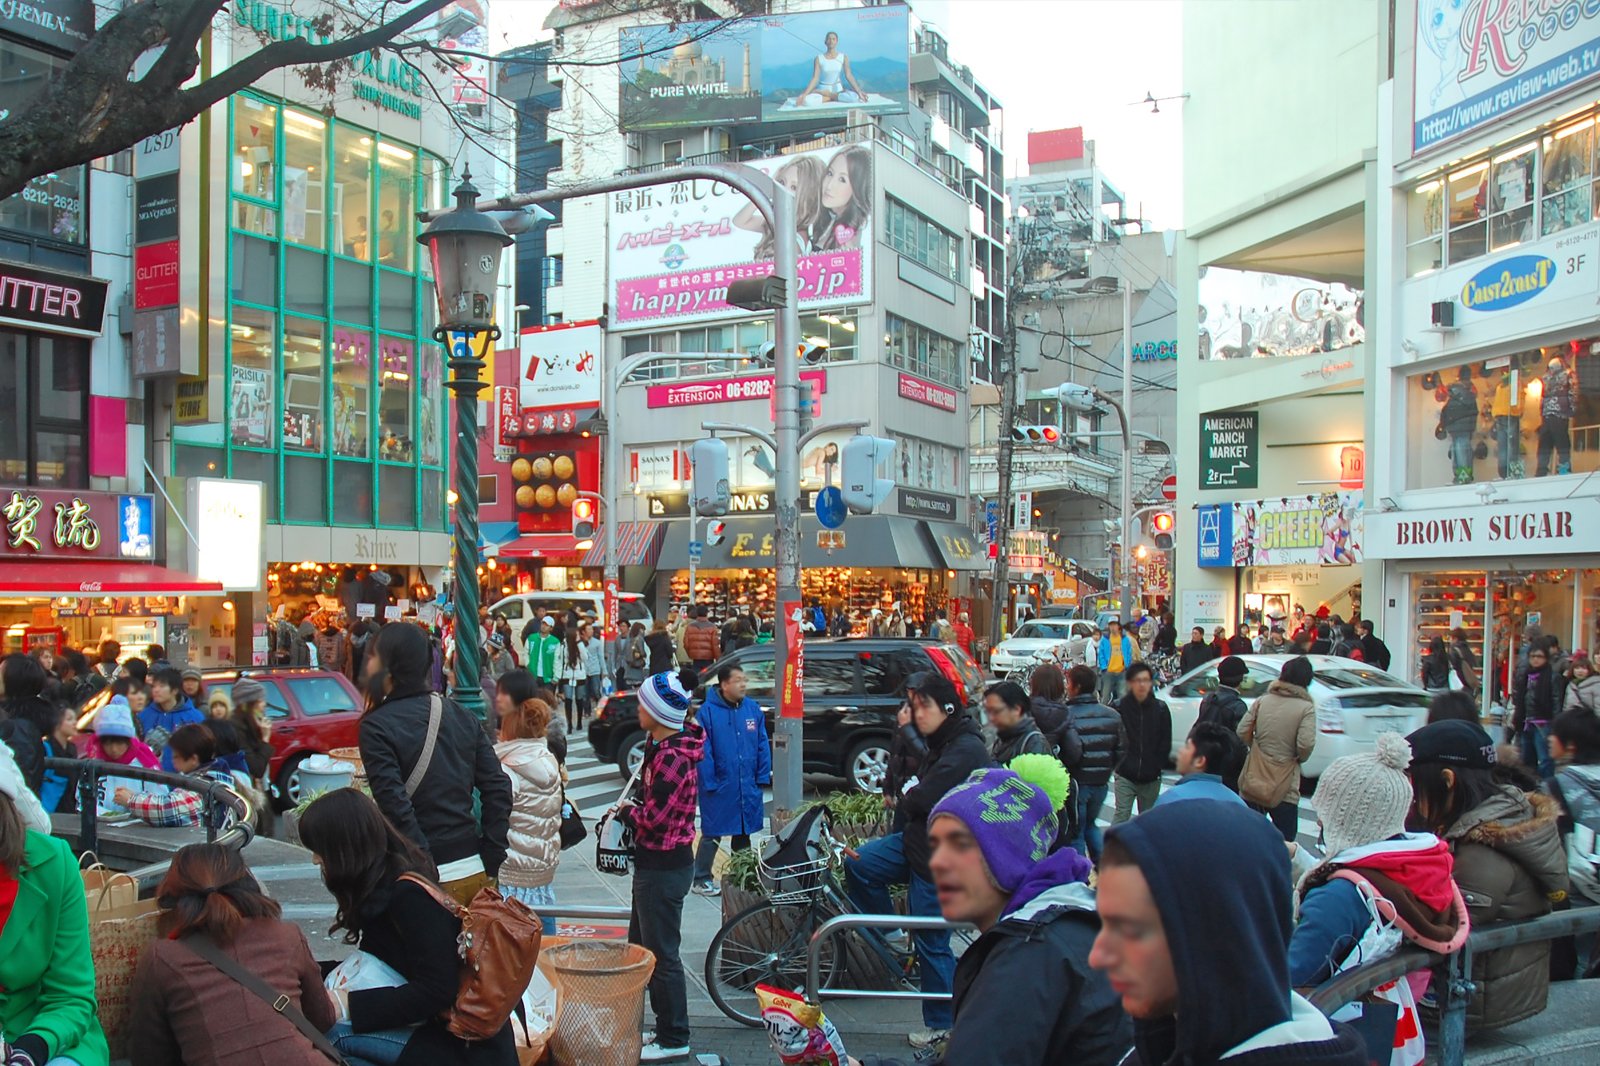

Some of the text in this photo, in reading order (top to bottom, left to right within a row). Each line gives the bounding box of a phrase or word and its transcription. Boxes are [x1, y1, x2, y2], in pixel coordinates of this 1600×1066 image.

[235, 0, 330, 45] SUNCIT
[650, 82, 729, 98] PURE WHITE
[144, 132, 174, 154] LSD
[615, 178, 741, 214] 最近、恋して
[617, 217, 732, 251] ハッピーメール
[137, 262, 178, 280] GLITTER
[1566, 254, 1586, 274] 3F
[1122, 340, 1177, 362] ARCO
[232, 368, 265, 382] PRISILA
[668, 380, 776, 404] EXTENSION 06-6282-
[1205, 417, 1253, 431] AMERICAN
[1213, 432, 1245, 445] RANCH
[641, 456, 670, 464] SANNA'S
[1210, 446, 1248, 459] MARKET
[1350, 458, 1361, 472] 10
[1208, 469, 1219, 482] 2F
[1259, 509, 1324, 550] CHEER
[1397, 511, 1573, 545] BROWN SUGAR
[731, 549, 756, 557] Face
[600, 853, 628, 869] EFFOR
[772, 997, 792, 1009] Calbee
